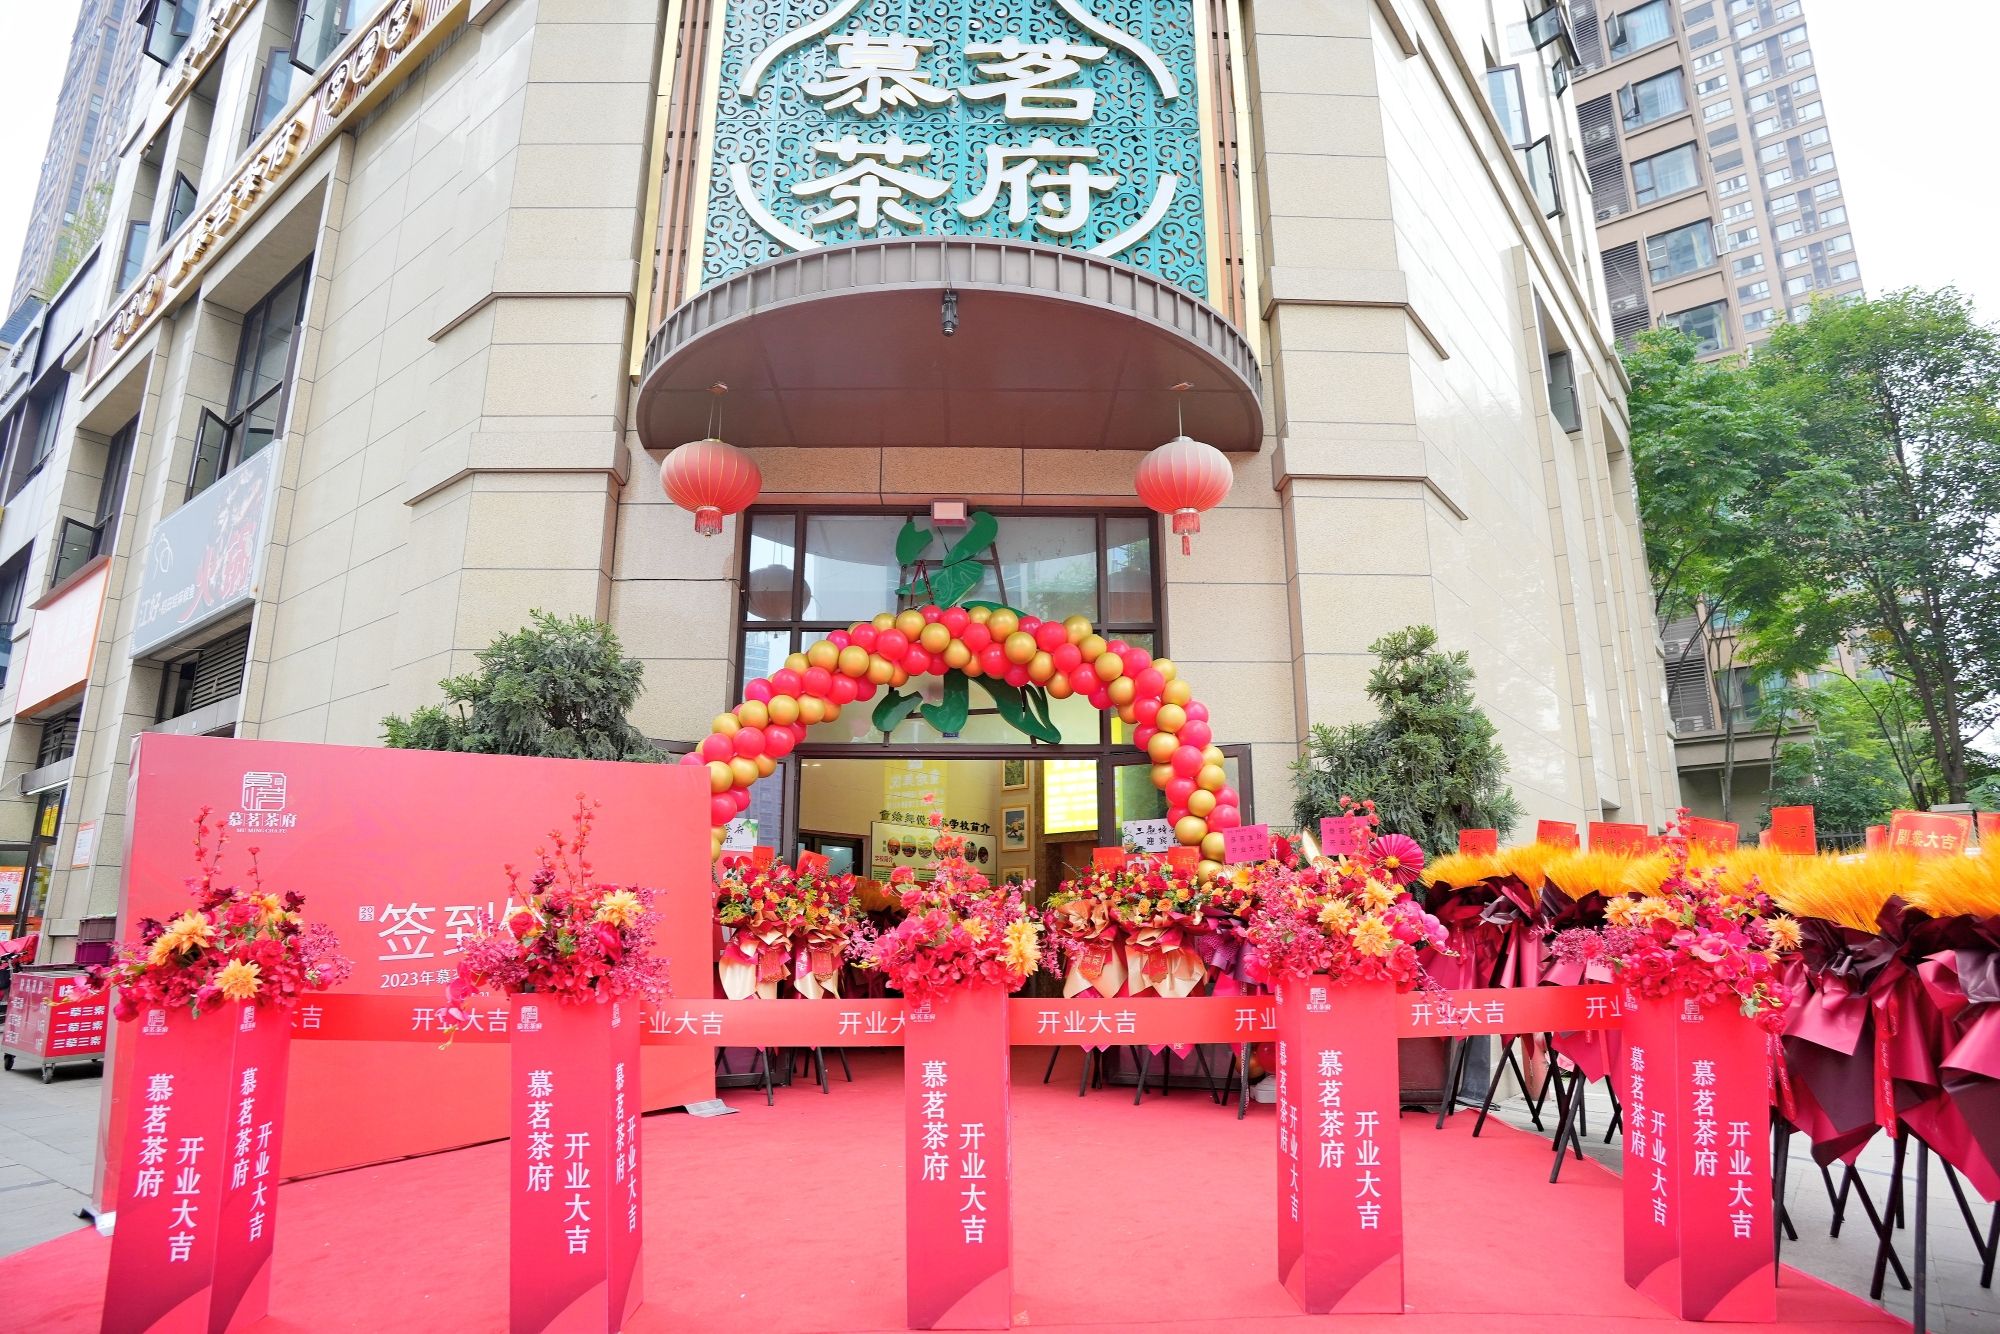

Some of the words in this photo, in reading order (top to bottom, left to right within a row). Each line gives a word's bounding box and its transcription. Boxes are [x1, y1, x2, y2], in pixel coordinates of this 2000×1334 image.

[801, 29, 1110, 125] 慕茗
[790, 134, 1121, 235] 茶府
[228, 812, 297, 828] 慕茗茶府
[640, 1011, 724, 1036] 业大吉
[1037, 1009, 1137, 1035] 开业大吉
[1411, 999, 1505, 1027] 开业大吉
[133, 1073, 175, 1198] 慕茗茶府
[230, 1067, 259, 1192] 慕茗茶府
[526, 1070, 554, 1193] 慕茗茶府
[615, 1062, 626, 1185] 慕茗茶府
[921, 1060, 949, 1182] 慕茗茶府
[1279, 1040, 1288, 1154] 慕茗茶府
[1317, 1050, 1345, 1169] 慕茗茶府
[1630, 1045, 1646, 1158] 慕茗茶府
[1692, 1060, 1719, 1177] 慕茗茶府
[168, 1135, 205, 1263] 开业大吉
[247, 1121, 273, 1243] 开业大吉
[563, 1131, 591, 1255] 开业大吉
[626, 1114, 637, 1233] 开业大吉
[959, 1122, 987, 1244] 开业大吉
[1288, 1104, 1299, 1222] 开业大吉
[1354, 1110, 1382, 1230] 开业大吉
[1650, 1109, 1668, 1227] 开业大吉
[1727, 1121, 1754, 1239] 开业大吉
